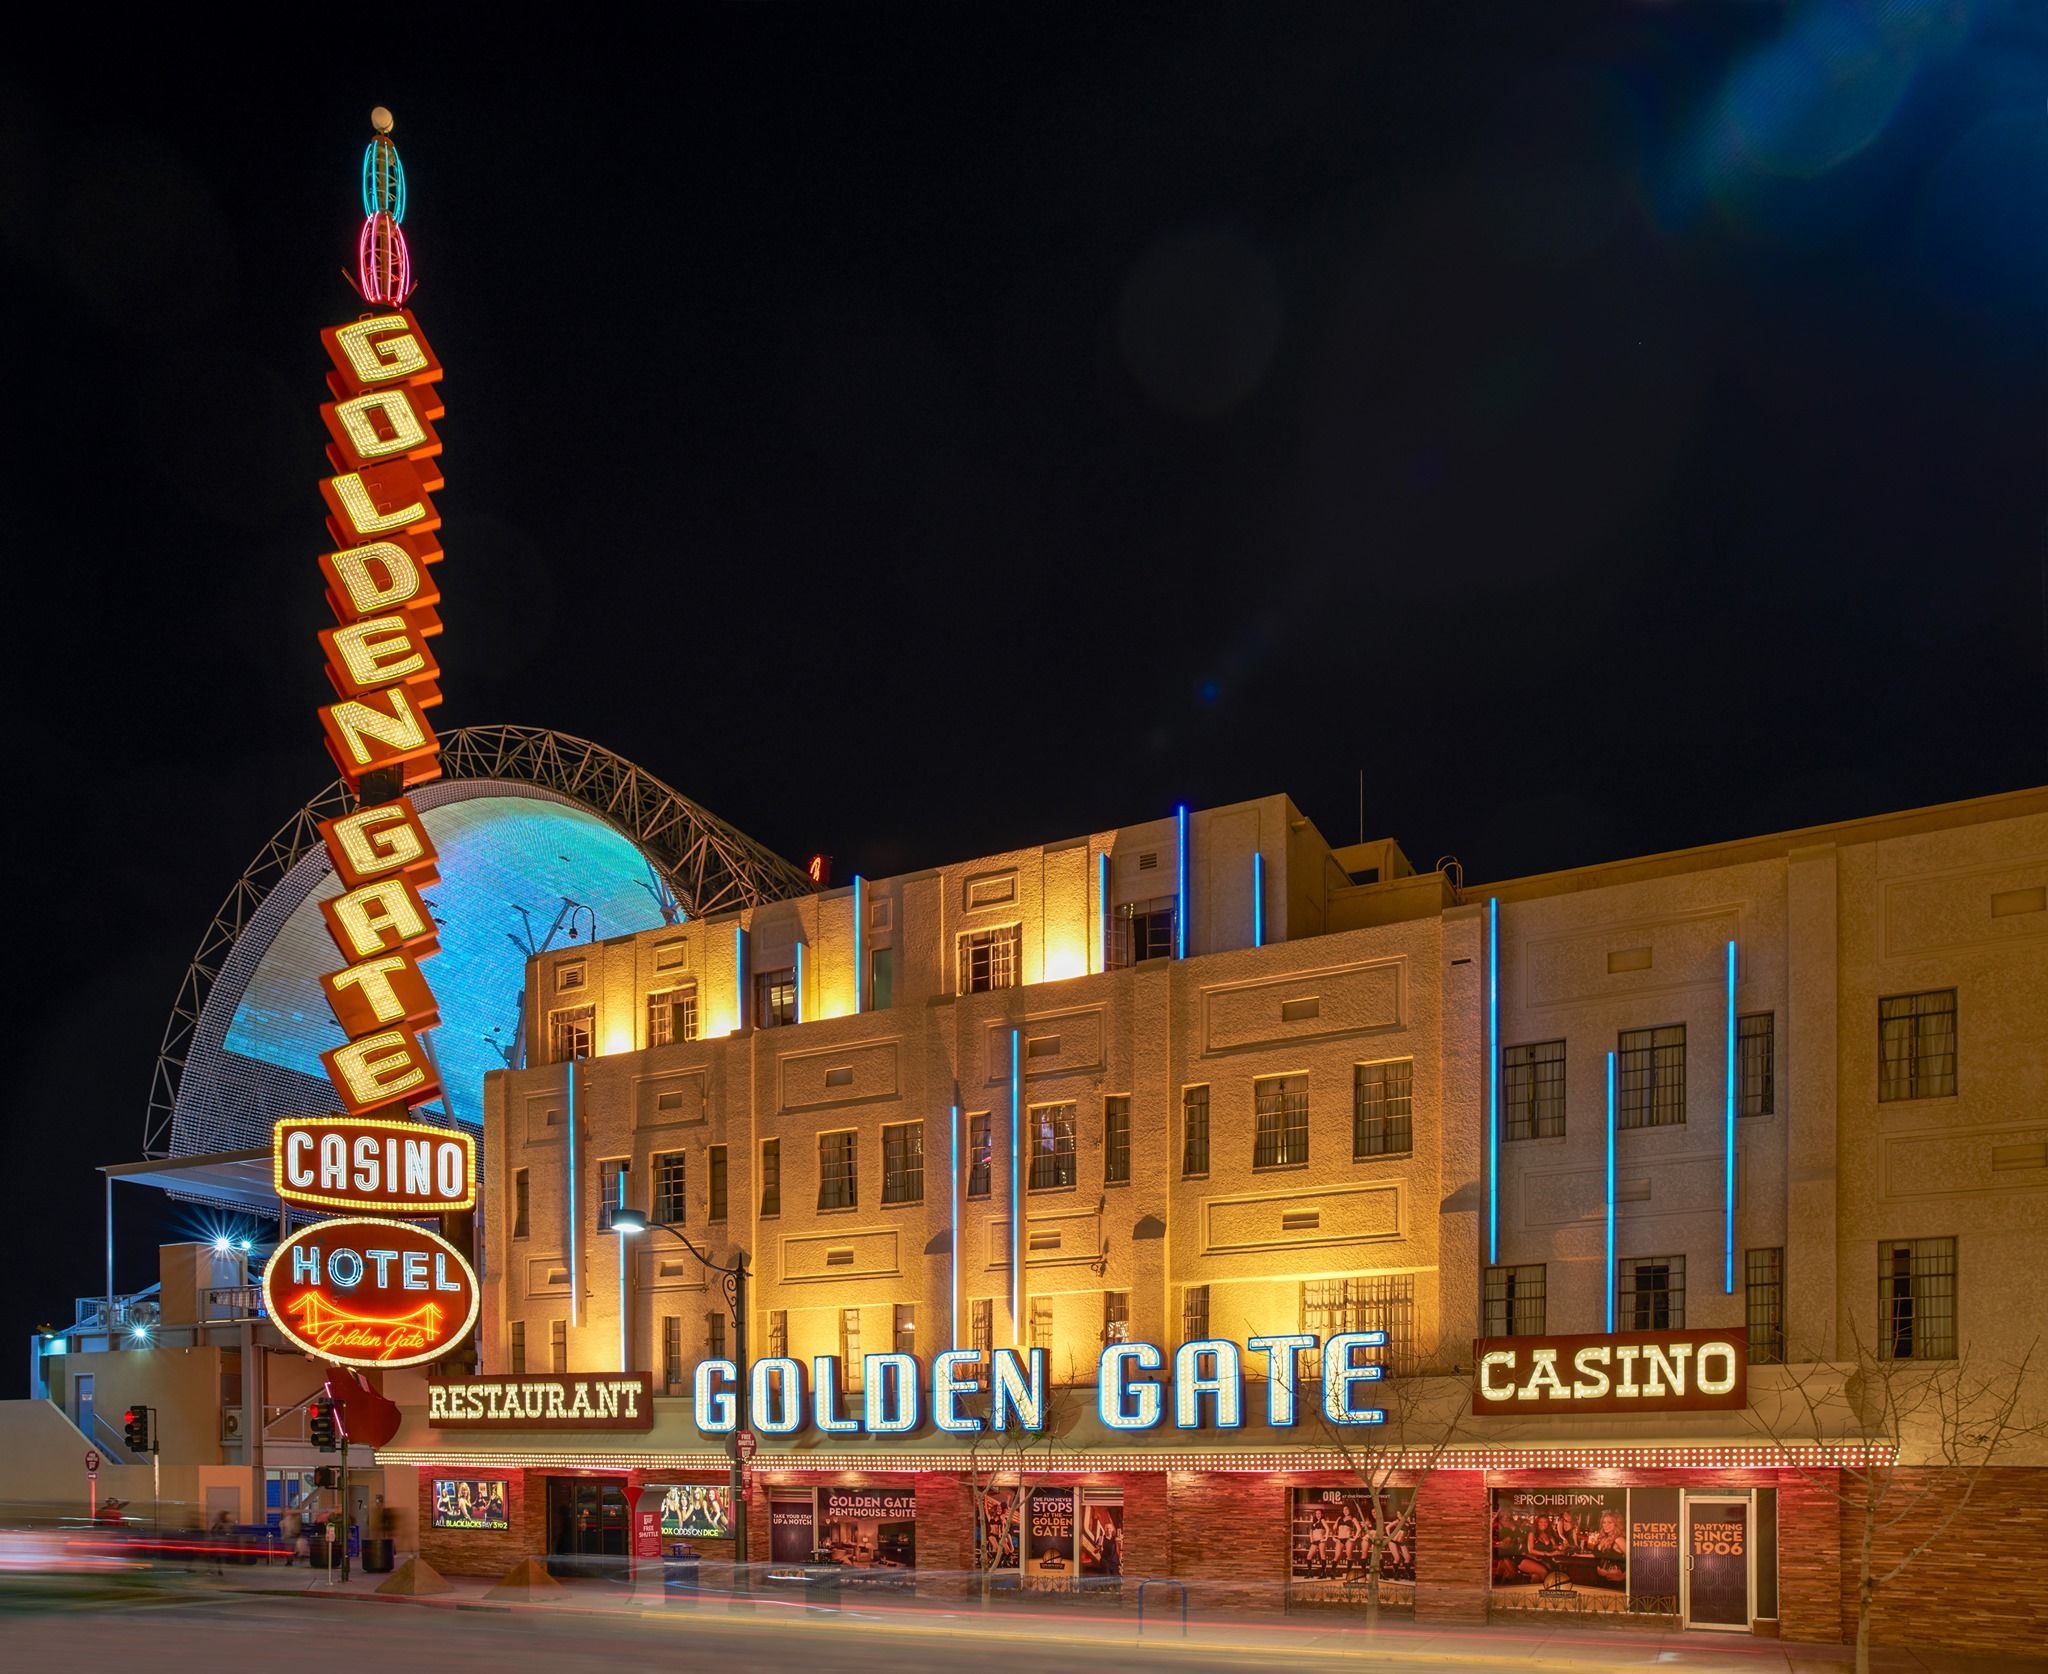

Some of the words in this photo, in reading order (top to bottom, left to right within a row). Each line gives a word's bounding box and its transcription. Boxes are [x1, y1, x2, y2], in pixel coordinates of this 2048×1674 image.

[331, 314, 429, 765] GOLDEN
[332, 804, 428, 1105] GATE
[287, 1130, 463, 1198] CASINO
[293, 1245, 461, 1291] HOTEL
[315, 1322, 382, 1353] Golden
[378, 1326, 425, 1361] Gate
[1480, 1341, 1736, 1401] CASINO
[693, 1348, 1046, 1434] GOLDEN
[1098, 1331, 1388, 1430] GATE
[428, 1381, 642, 1420] RESTAURANT
[829, 1496, 880, 1507] GOLDEN
[884, 1497, 916, 1508] GATE
[1033, 1502, 1073, 1513] STOPS
[829, 1507, 886, 1517] PENTHOUSE
[888, 1508, 916, 1518] SUITE
[435, 1519, 446, 1527] ALL
[446, 1520, 482, 1528] BLACKJACKS
[482, 1521, 492, 1529] PAY
[503, 1521, 508, 1529] 2
[788, 1518, 812, 1526] NOTCH
[1032, 1517, 1073, 1526] GOLDEN
[1693, 1523, 1743, 1531] PARTYING
[673, 1527, 691, 1536] ODDS
[691, 1528, 703, 1537] ON
[703, 1528, 719, 1537] DICE
[1032, 1525, 1073, 1537] GATE.
[1633, 1522, 1677, 1533] EVERY
[1633, 1532, 1665, 1540] NIGHT
[1667, 1532, 1677, 1540] IS
[1694, 1531, 1743, 1542] SINCE
[1632, 1540, 1678, 1548] HISTORIC
[1694, 1542, 1743, 1556] 1906
